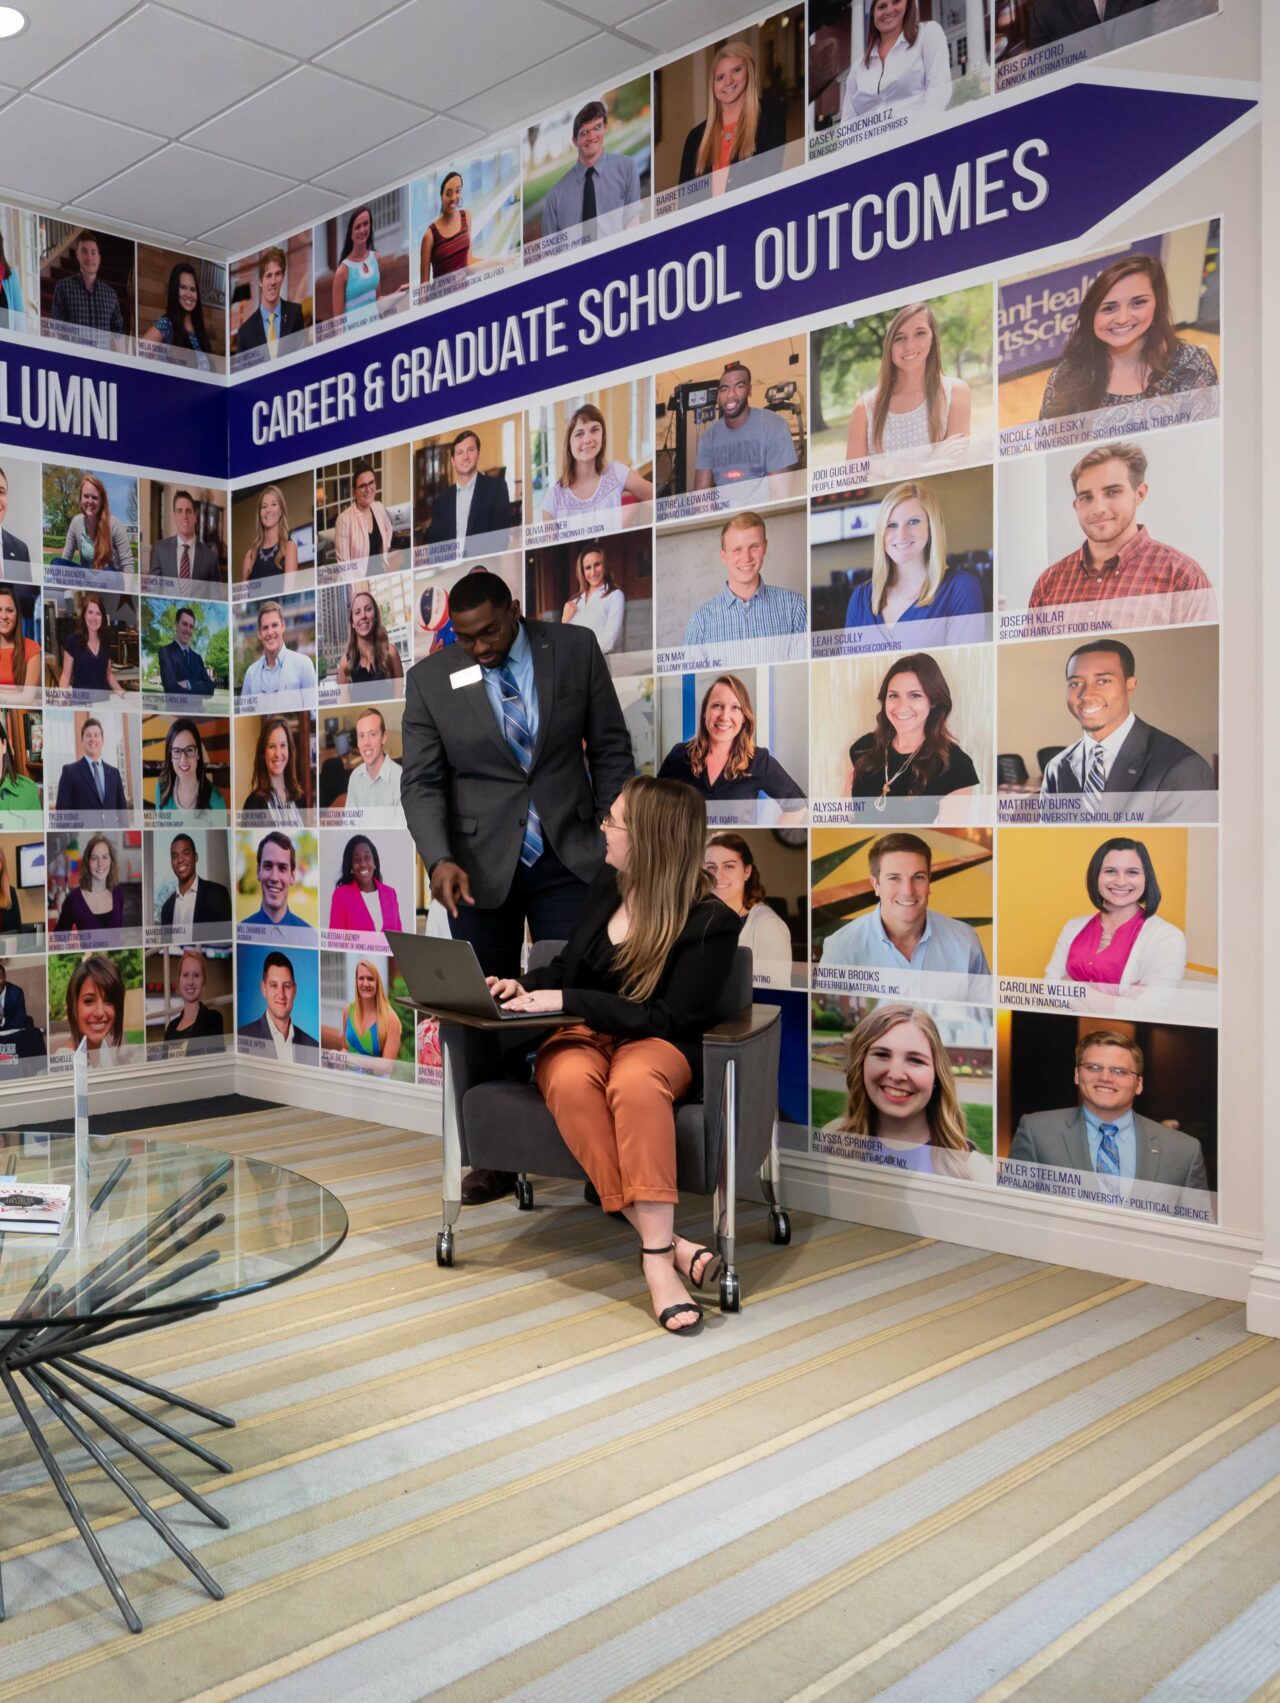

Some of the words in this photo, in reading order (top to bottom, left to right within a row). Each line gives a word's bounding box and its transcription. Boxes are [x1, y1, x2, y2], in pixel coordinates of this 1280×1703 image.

[997, 60, 1018, 78] KRIS
[1021, 43, 1064, 70] GAFFORD
[997, 71, 1027, 90] LENNOX
[1028, 48, 1088, 79] INTERNATIONAL
[809, 129, 835, 149] CASEY
[836, 108, 894, 139] SCHOENHOLTZ
[656, 186, 685, 207] BARRETT
[687, 177, 709, 195] SOUTH
[523, 241, 542, 257] KEVIN
[542, 231, 568, 250] SANDERS
[252, 371, 356, 446] CAREER
[364, 361, 385, 412] &
[391, 298, 569, 403] GRADUATE
[578, 245, 742, 345] SCHOOL
[754, 138, 1050, 292] OUTCOMES
[1000, 428, 1032, 445] NICOLE
[1034, 417, 1086, 438] KARLESKY
[812, 468, 828, 481] JODI
[829, 461, 870, 478] GUGLIELMI
[812, 479, 834, 492] PEOPLE
[836, 474, 869, 488] MAGAZINE
[656, 496, 686, 511] DERRELL
[687, 490, 720, 506] EDWARDS
[1000, 613, 1034, 628] JOSEPH
[1036, 610, 1065, 624] KILAR
[812, 635, 832, 647] LEAH
[834, 632, 863, 645] SCULLY
[1000, 628, 1029, 640] SECOND
[1031, 624, 1066, 637] HARVEST
[1068, 622, 1089, 633] FOOD
[1090, 620, 1113, 631] BANK
[657, 652, 670, 663] BEN
[671, 651, 686, 662] MAY
[813, 802, 842, 812] ALYSSA
[844, 801, 866, 812] HUNT
[1000, 799, 1045, 810] MATTHEW
[1050, 798, 1081, 809] BURNS
[999, 813, 1031, 822] HOWARD
[1033, 812, 1078, 822] UNIVERSITY
[1080, 812, 1111, 822] SCHOOL
[1113, 812, 1123, 822] OF
[1125, 812, 1145, 822] LAW
[813, 967, 846, 979] ANDREW
[848, 969, 880, 982] BROOKS
[1000, 981, 1044, 994] CAROLINE
[1047, 984, 1086, 998] WELLER
[1000, 994, 1030, 1006] LINCOLN
[1032, 997, 1072, 1010] FINANCIAL
[812, 1132, 842, 1146] ALYSSA
[844, 1136, 883, 1151] SPRINGER
[999, 1162, 1028, 1177] TYLER
[1030, 1167, 1081, 1186] STEELMAN
